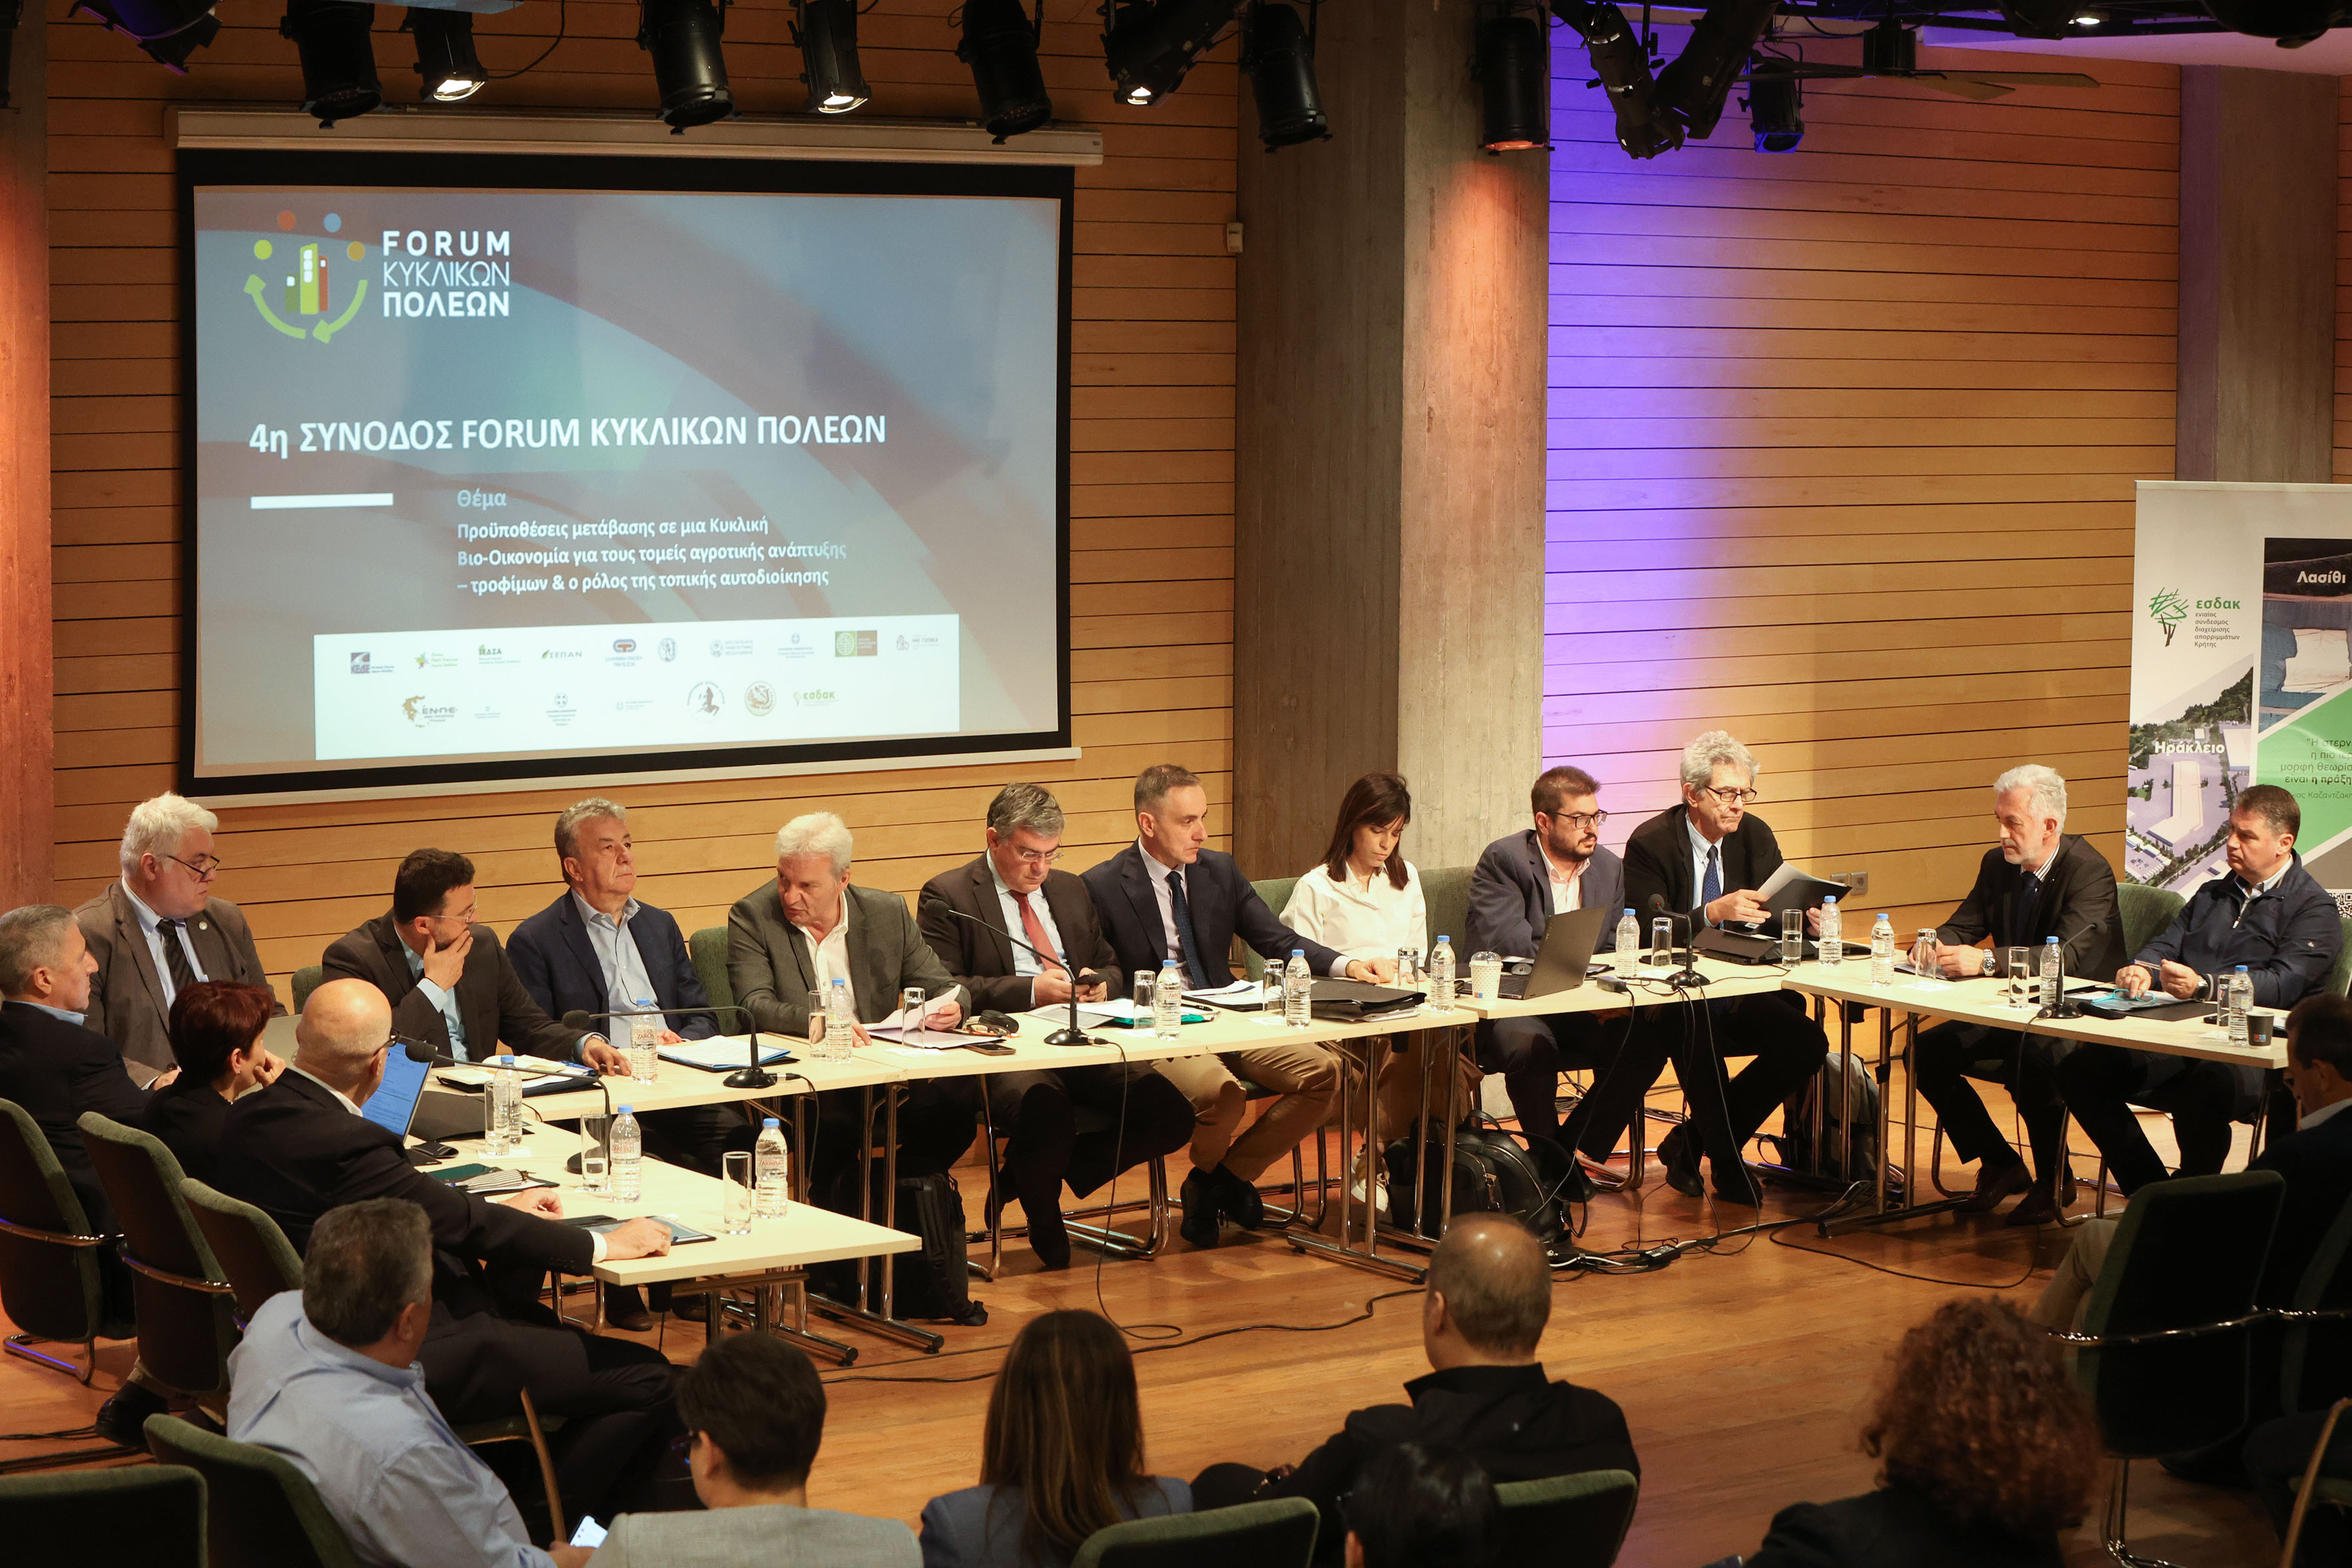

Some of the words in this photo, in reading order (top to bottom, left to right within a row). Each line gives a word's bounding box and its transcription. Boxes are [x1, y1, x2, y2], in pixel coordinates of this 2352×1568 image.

[382, 230, 510, 257] FORUM
[383, 260, 510, 287] ΚΥΚΛΙΚΩΝ
[383, 291, 510, 317] ΠΟΛΕΩΝ
[249, 423, 288, 459] 4η
[299, 420, 453, 452] ΣΥΝΟΔΟΣ
[463, 419, 580, 448] FORUM
[591, 416, 747, 446] ΚΥΚΛΙΚΩΝ
[757, 414, 886, 444] ΠΟΛΕΩΝ
[457, 489, 507, 510] Θέμα
[457, 520, 568, 542] Προϋποθέσεις
[572, 518, 655, 539] μετάβασης
[659, 521, 677, 534] σε
[680, 520, 706, 537] μια
[710, 515, 769, 535] Κυκλική
[457, 547, 570, 568] Βιο-Οικονομία
[573, 551, 597, 567] για
[601, 549, 636, 564] τους
[639, 544, 686, 564] τομείς
[690, 542, 765, 563] αγροτικής
[767, 541, 846, 560] ανάπτυξης
[471, 575, 548, 596] τροφίμων
[552, 574, 566, 590] &
[582, 573, 628, 593] ρόλος
[631, 575, 656, 591] της
[659, 570, 717, 589] τοπικής
[720, 568, 829, 587] αυτοδιοίκησης
[2296, 570, 2347, 584] Λασίθι
[2196, 596, 2241, 609] εσδακ
[2154, 740, 2226, 757] Ηράκλειο
[2311, 752, 2317, 761] η
[2280, 762, 2314, 773] μορφή
[2284, 774, 2308, 783] είναι
[2312, 776, 2317, 785] η
[2321, 774, 2351, 785] πράξη
